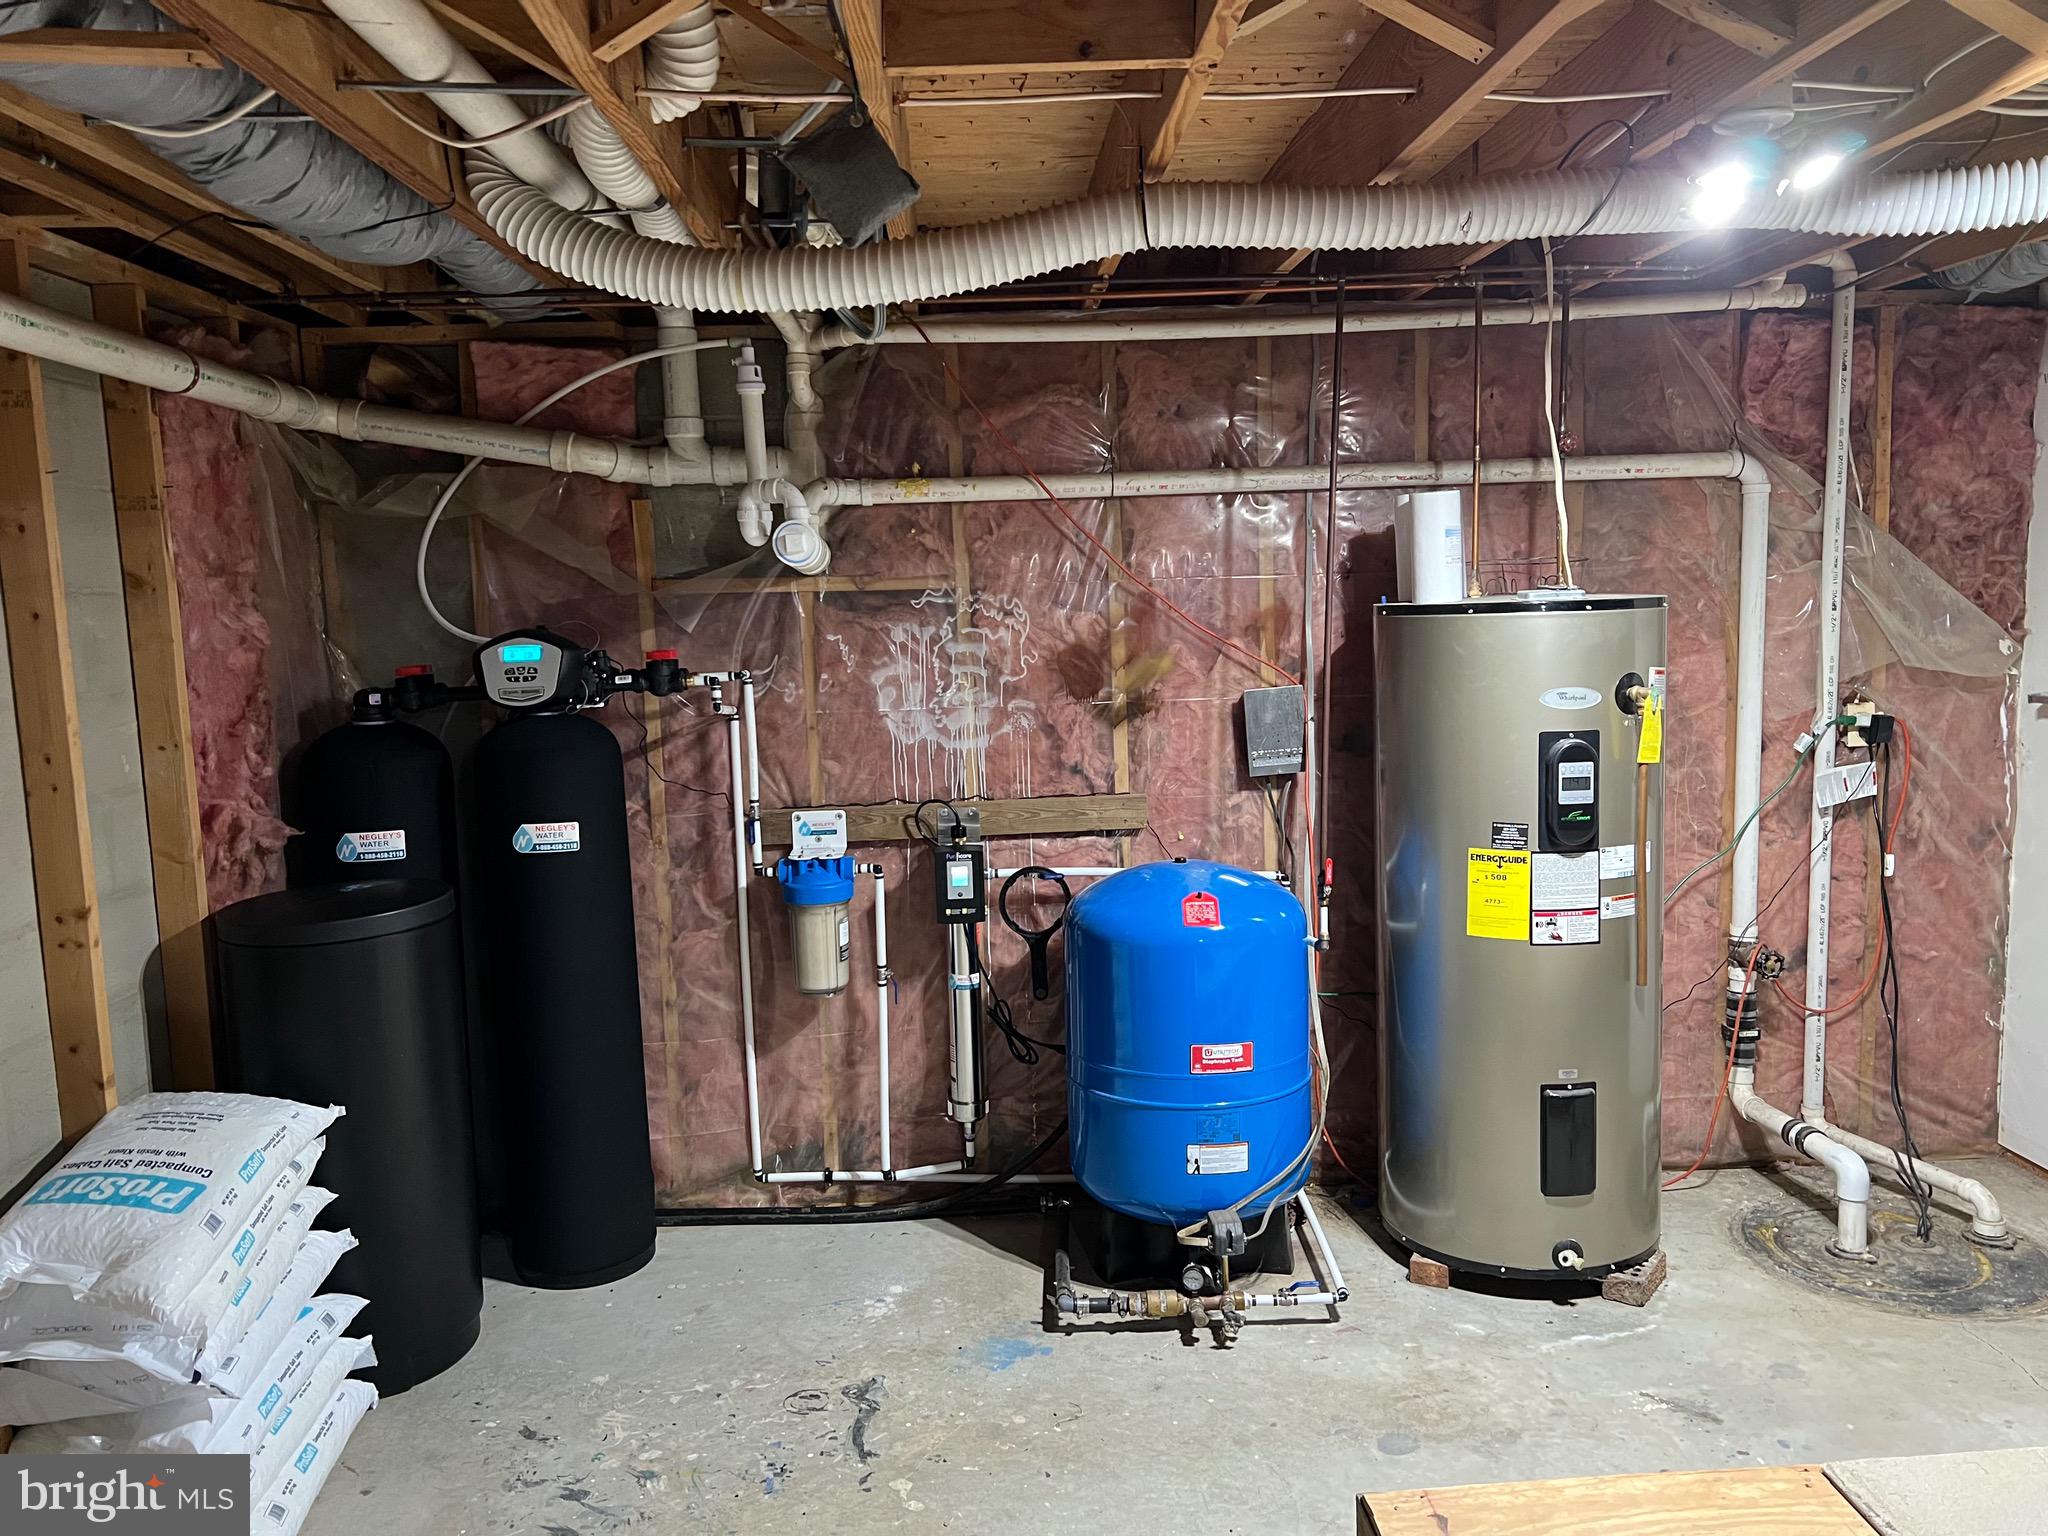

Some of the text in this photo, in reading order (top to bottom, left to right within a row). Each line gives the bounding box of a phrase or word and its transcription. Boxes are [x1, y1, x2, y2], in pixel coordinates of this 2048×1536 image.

[358, 831, 402, 841] NEGLEY'S
[535, 823, 576, 832] NEGLEY'S
[359, 840, 389, 848] WATER
[1470, 853, 1528, 868] ENERGYGUIDE
[136, 1148, 164, 1156] Resin
[60, 1158, 214, 1179] Compacted Salt Cubes
[241, 1149, 265, 1180] ProSoft
[38, 1175, 195, 1209] ProSoft
[234, 1233, 254, 1263] ProSoft
[259, 1386, 281, 1417] ProSoft
[296, 1444, 317, 1472] ProSoft
